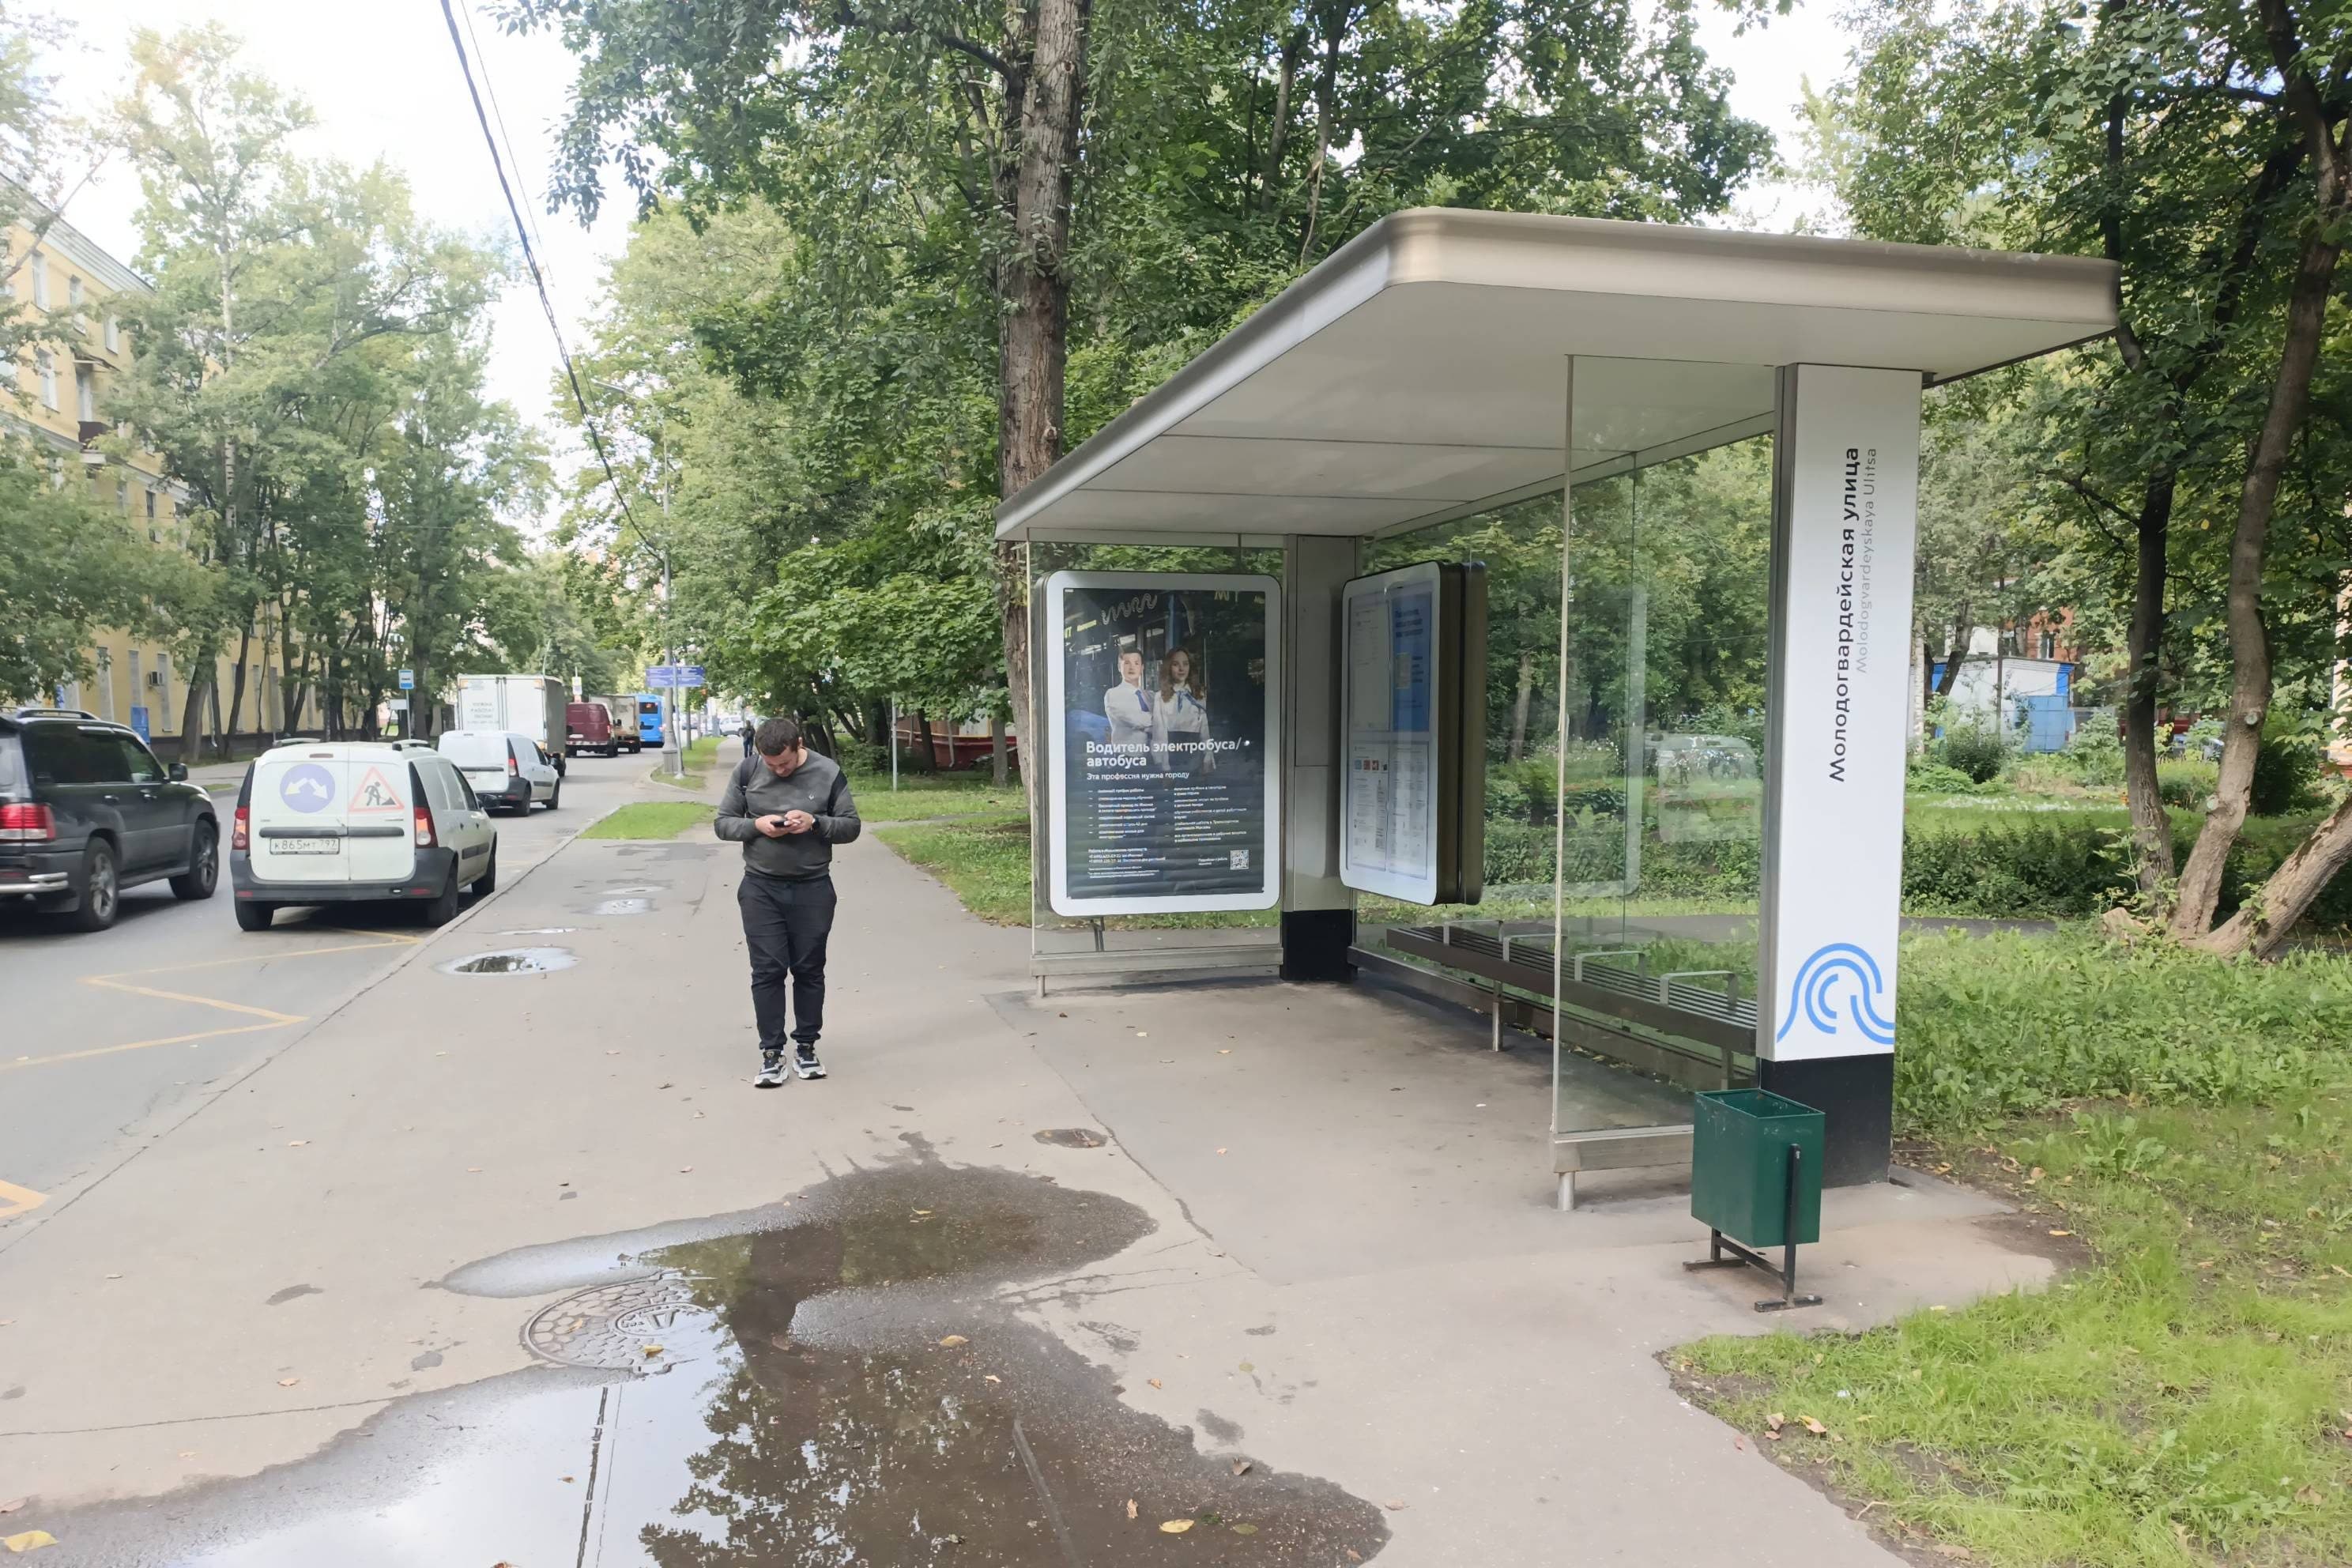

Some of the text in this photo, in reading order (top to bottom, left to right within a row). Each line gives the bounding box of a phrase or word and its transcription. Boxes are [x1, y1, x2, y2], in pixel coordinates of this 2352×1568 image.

[1856, 448, 1876, 673] Molodogvardeyskaya Ulitsa
[1829, 448, 1860, 782] Молодогвардейская улица
[1086, 737, 1241, 754] Водитель электробуса/
[1087, 755, 1147, 768] автобуса
[1101, 772, 1140, 781] профессия
[1165, 771, 1189, 780] городу
